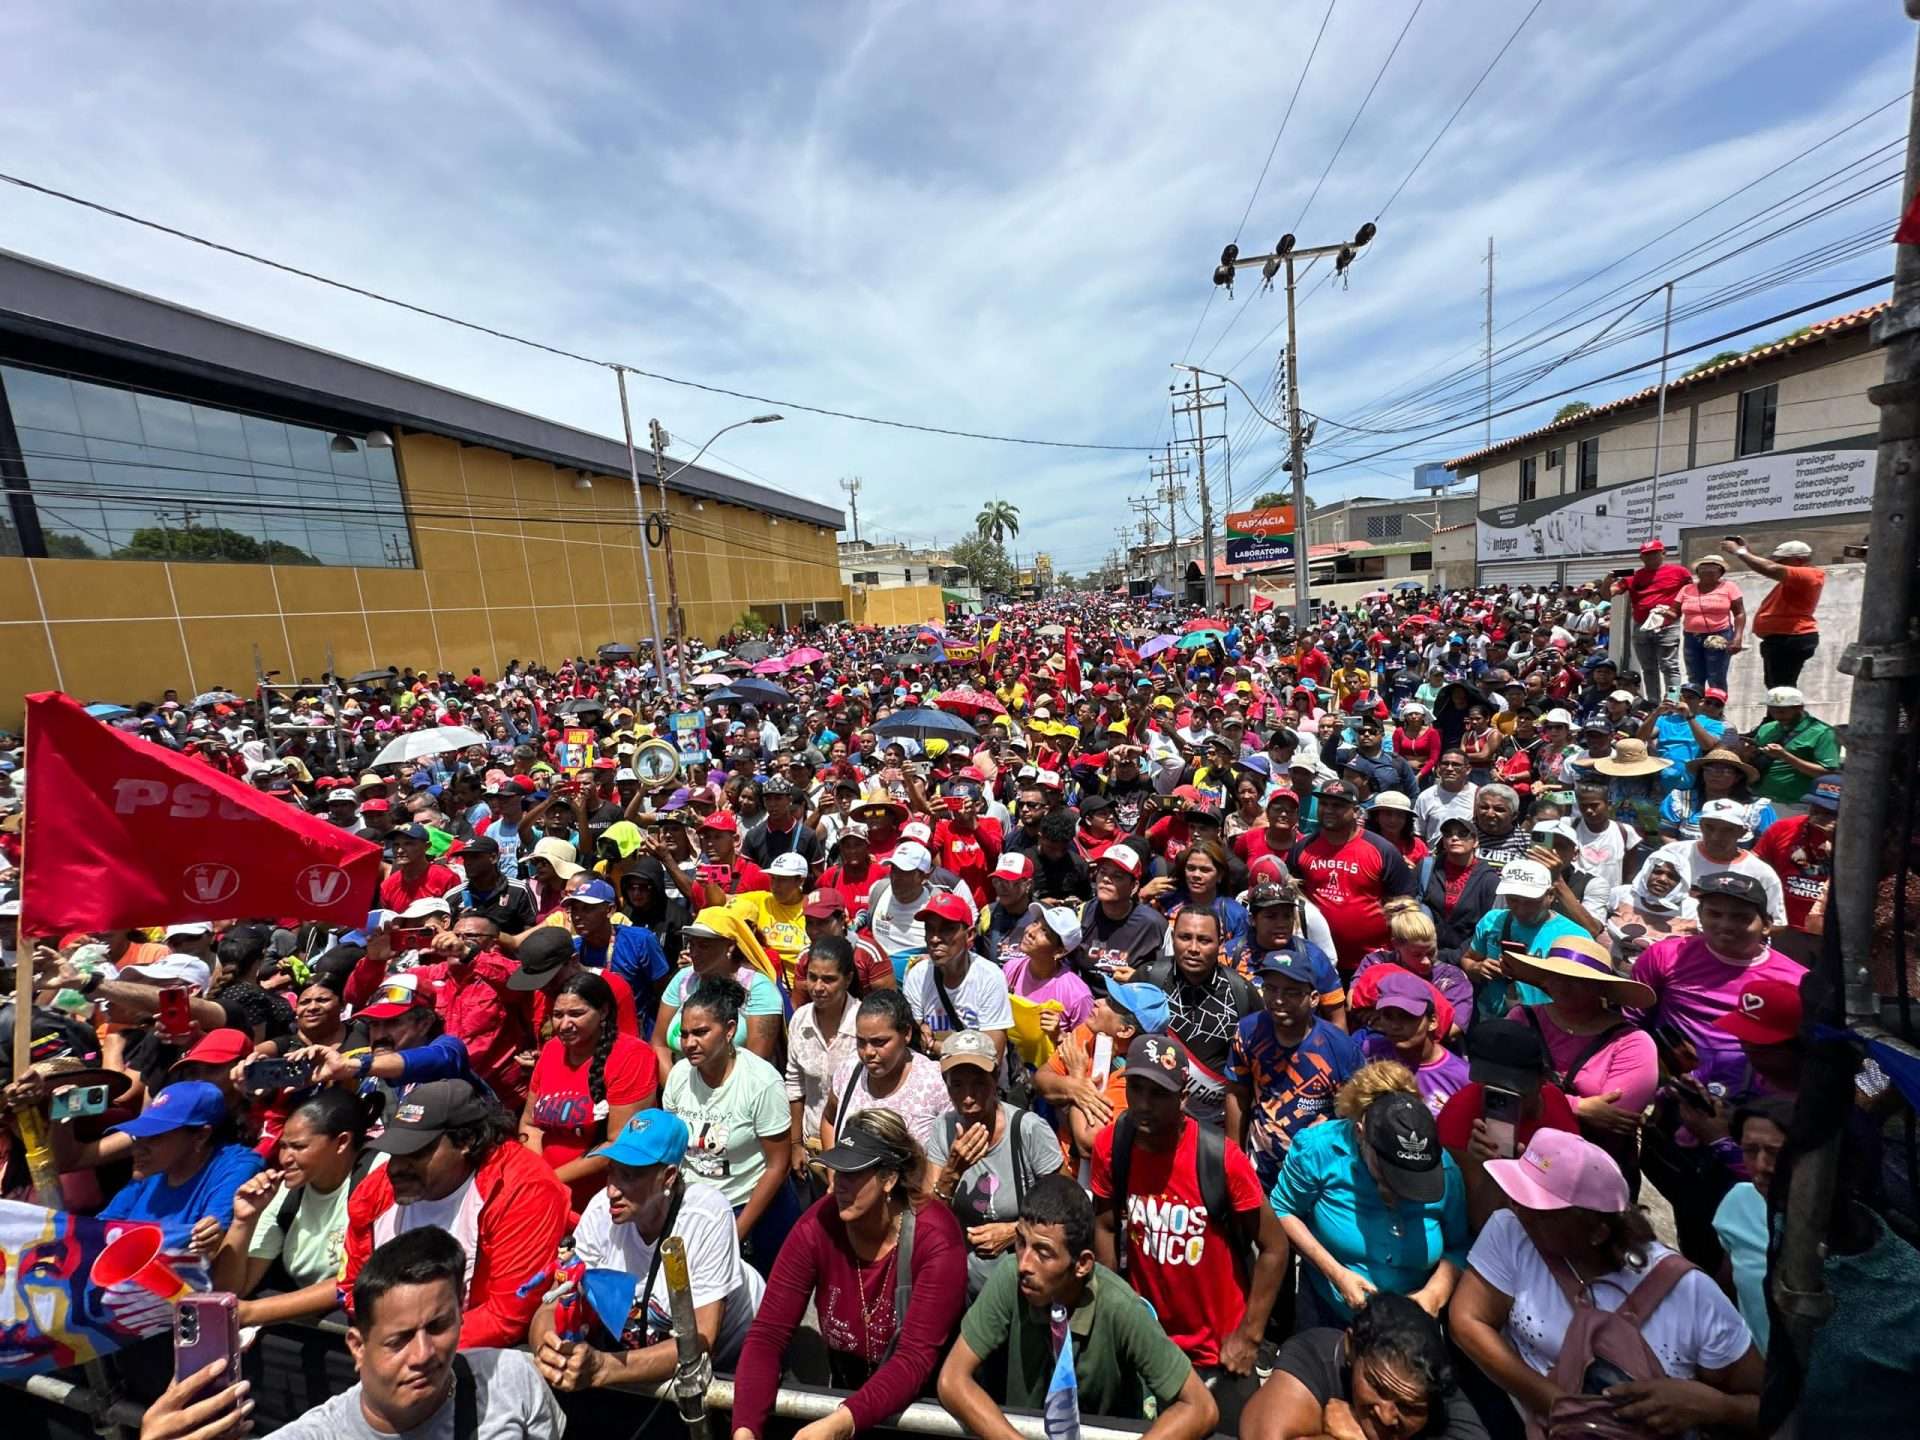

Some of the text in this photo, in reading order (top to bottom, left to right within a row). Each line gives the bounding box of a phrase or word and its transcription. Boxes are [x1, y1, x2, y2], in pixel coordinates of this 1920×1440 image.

[1493, 537, 1518, 553] Integra
[1234, 547, 1289, 559] LABORATORIO
[1310, 859, 1359, 874] ANGELS
[1397, 1150, 1432, 1161] adidas
[1143, 1227, 1205, 1266] NICO
